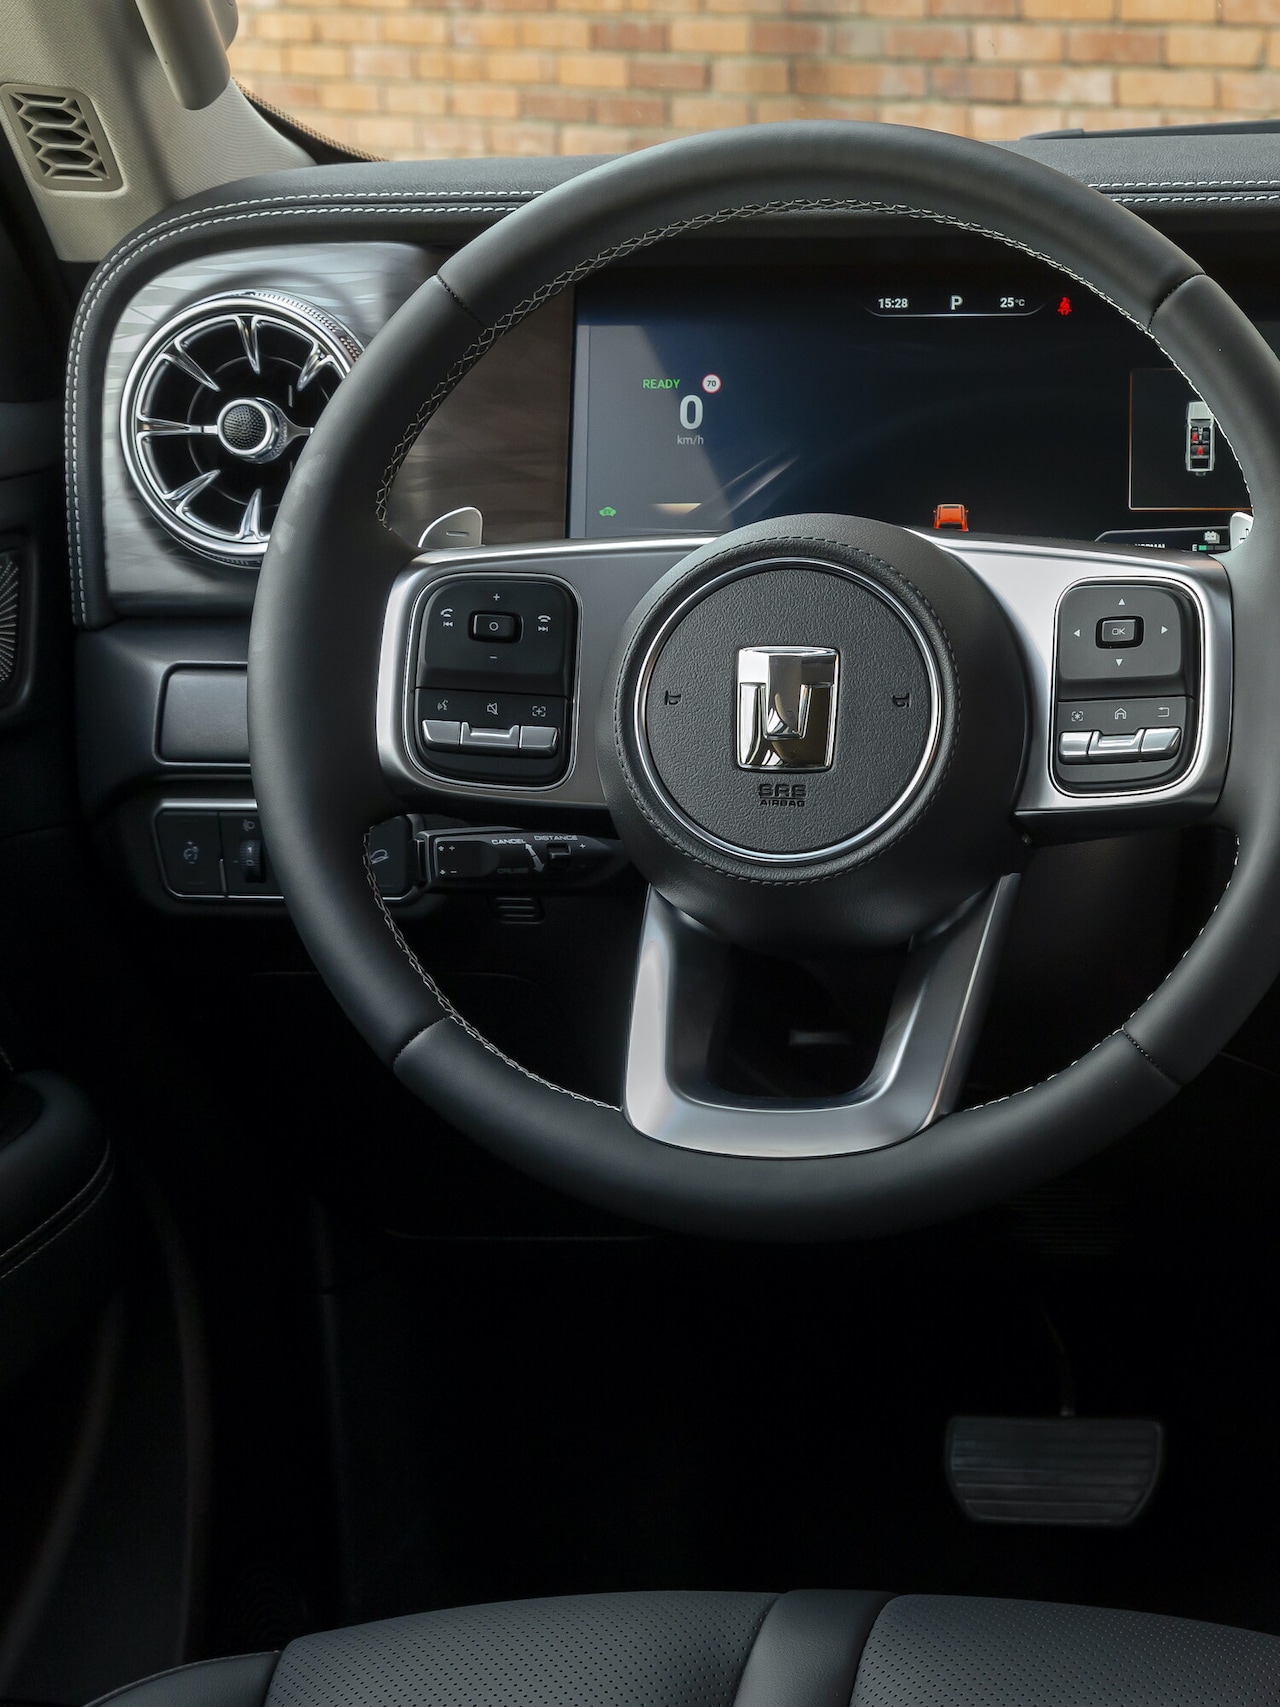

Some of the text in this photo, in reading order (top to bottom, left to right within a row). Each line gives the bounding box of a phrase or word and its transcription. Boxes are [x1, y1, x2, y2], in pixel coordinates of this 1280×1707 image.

[878, 298, 909, 309] 15:28
[950, 295, 963, 311] P
[642, 378, 681, 390] READY
[706, 379, 717, 388] 70
[679, 395, 704, 430] 0
[676, 435, 704, 445] km/h
[1111, 627, 1126, 636] OK
[758, 783, 807, 798] SRS
[759, 799, 806, 808] AIRBAG
